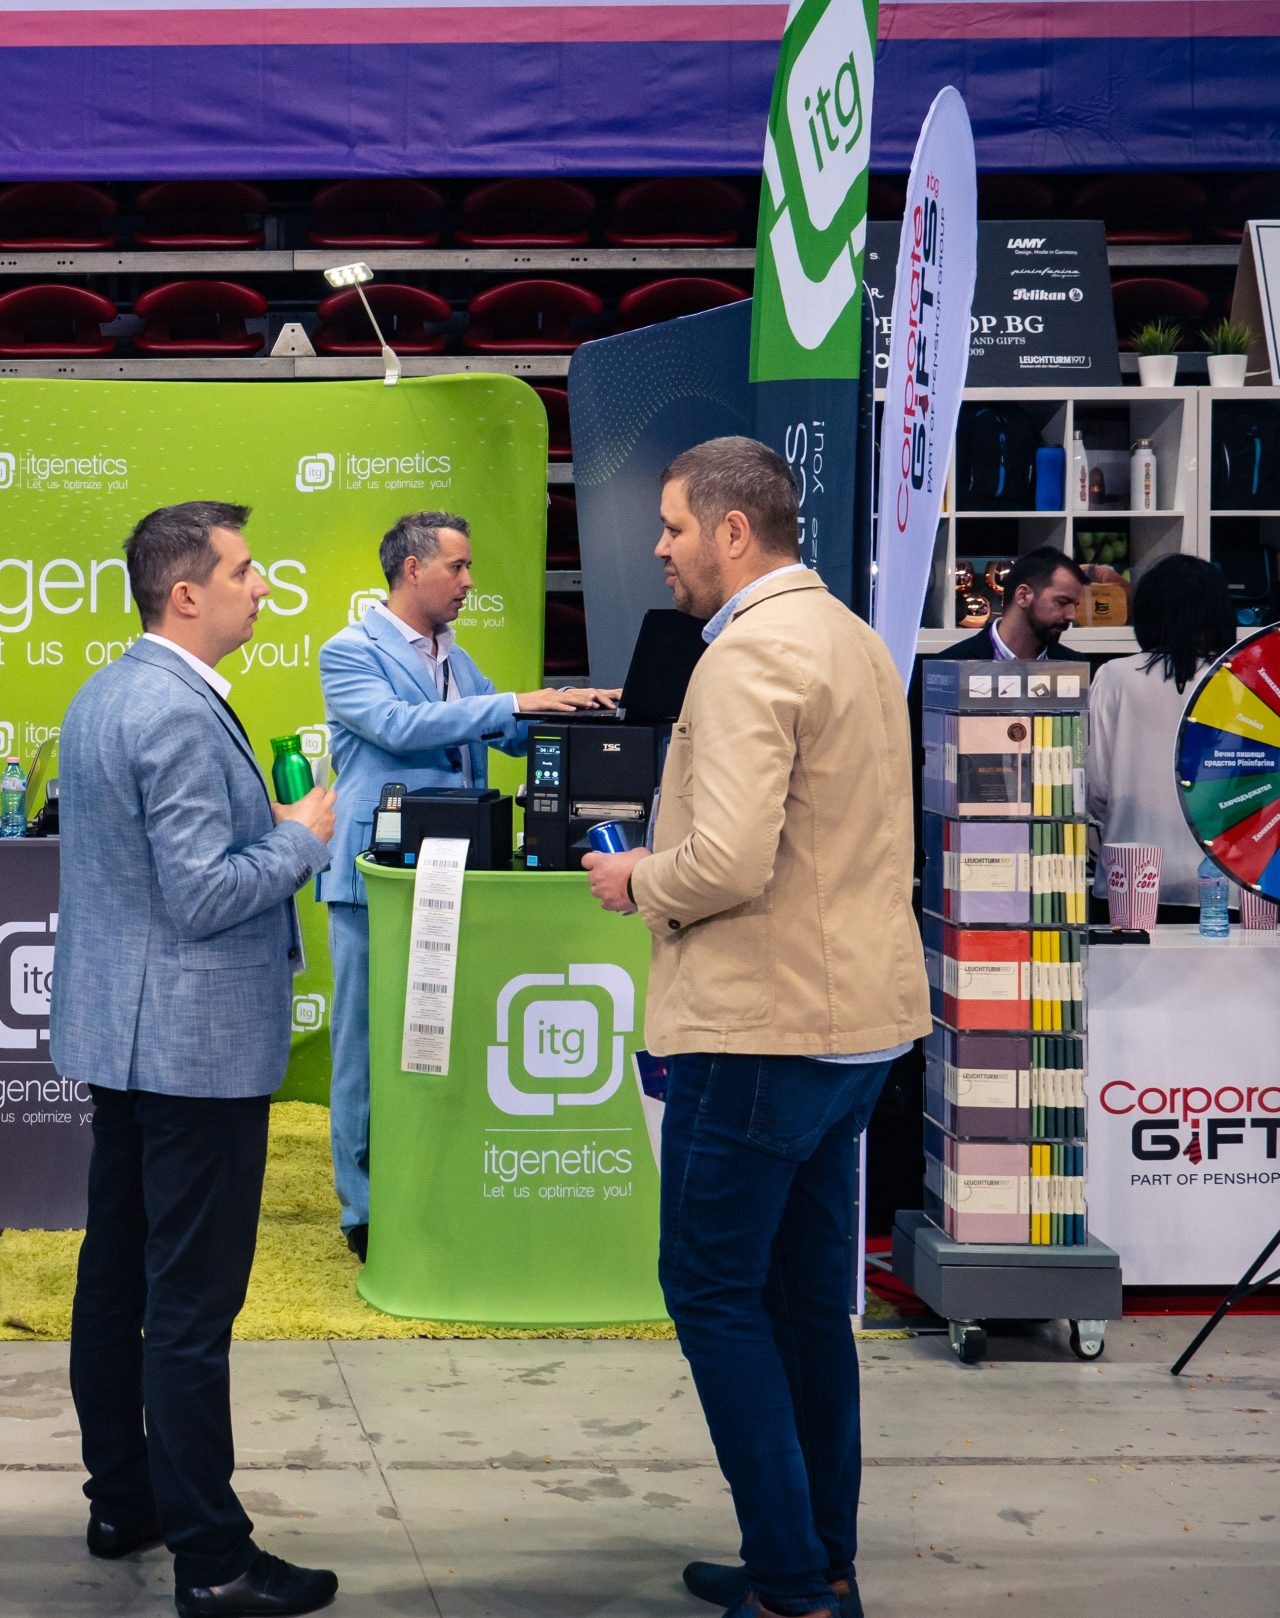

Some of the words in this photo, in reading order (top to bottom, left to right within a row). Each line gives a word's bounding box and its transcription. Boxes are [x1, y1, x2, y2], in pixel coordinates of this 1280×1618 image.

[805, 49, 863, 173] itg
[1007, 238, 1047, 249] LAMY
[1012, 288, 1066, 301] Pelikan
[972, 337, 994, 345] AND
[996, 337, 1026, 345] GIFTS
[1019, 356, 1086, 364] LEUCHTTURM1917
[896, 205, 924, 534] Corporate
[930, 398, 936, 432] OF
[812, 421, 825, 494] you!
[26, 452, 128, 479] itgenetics
[346, 451, 451, 480] itgenetics
[308, 467, 322, 479] itg
[26, 479, 42, 489] Let
[47, 481, 58, 489] us
[63, 479, 102, 491] optimize
[107, 479, 128, 491] you!
[346, 479, 361, 489] Let
[384, 478, 424, 490] optimize
[430, 477, 451, 489] you!
[483, 617, 504, 628] you!
[26, 641, 64, 665] us
[240, 635, 310, 674] you!
[305, 737, 319, 750] itg
[1237, 759, 1275, 767] Pininfarina
[299, 1006, 313, 1019] itg
[538, 1020, 585, 1064] itg
[1, 1112, 15, 1123] us
[22, 1110, 72, 1125] optimize
[484, 1141, 633, 1183] itgenetics
[1131, 1174, 1172, 1186] PART
[1176, 1174, 1198, 1185] OF
[483, 1183, 505, 1198] Let
[513, 1186, 530, 1198] us
[538, 1183, 595, 1200] optimize
[603, 1182, 633, 1200] you!
